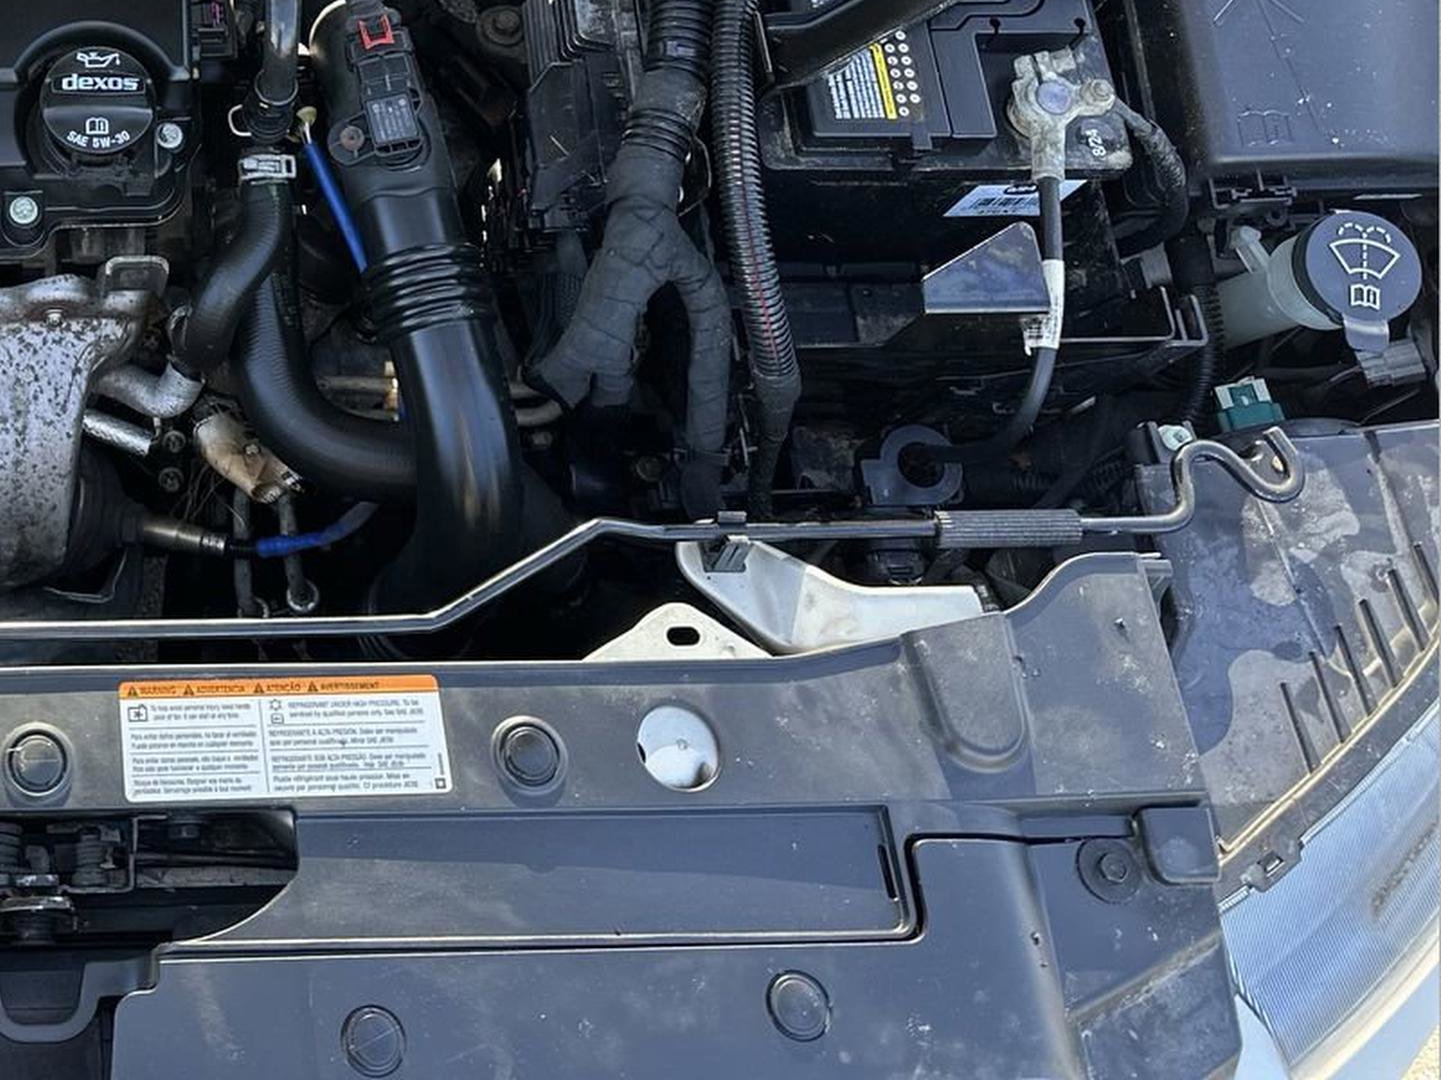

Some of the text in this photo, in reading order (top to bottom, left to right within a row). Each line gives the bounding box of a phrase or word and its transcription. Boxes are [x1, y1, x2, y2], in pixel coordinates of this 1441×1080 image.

[62, 73, 140, 91] dexos
[66, 130, 130, 149] SAE 5W-30
